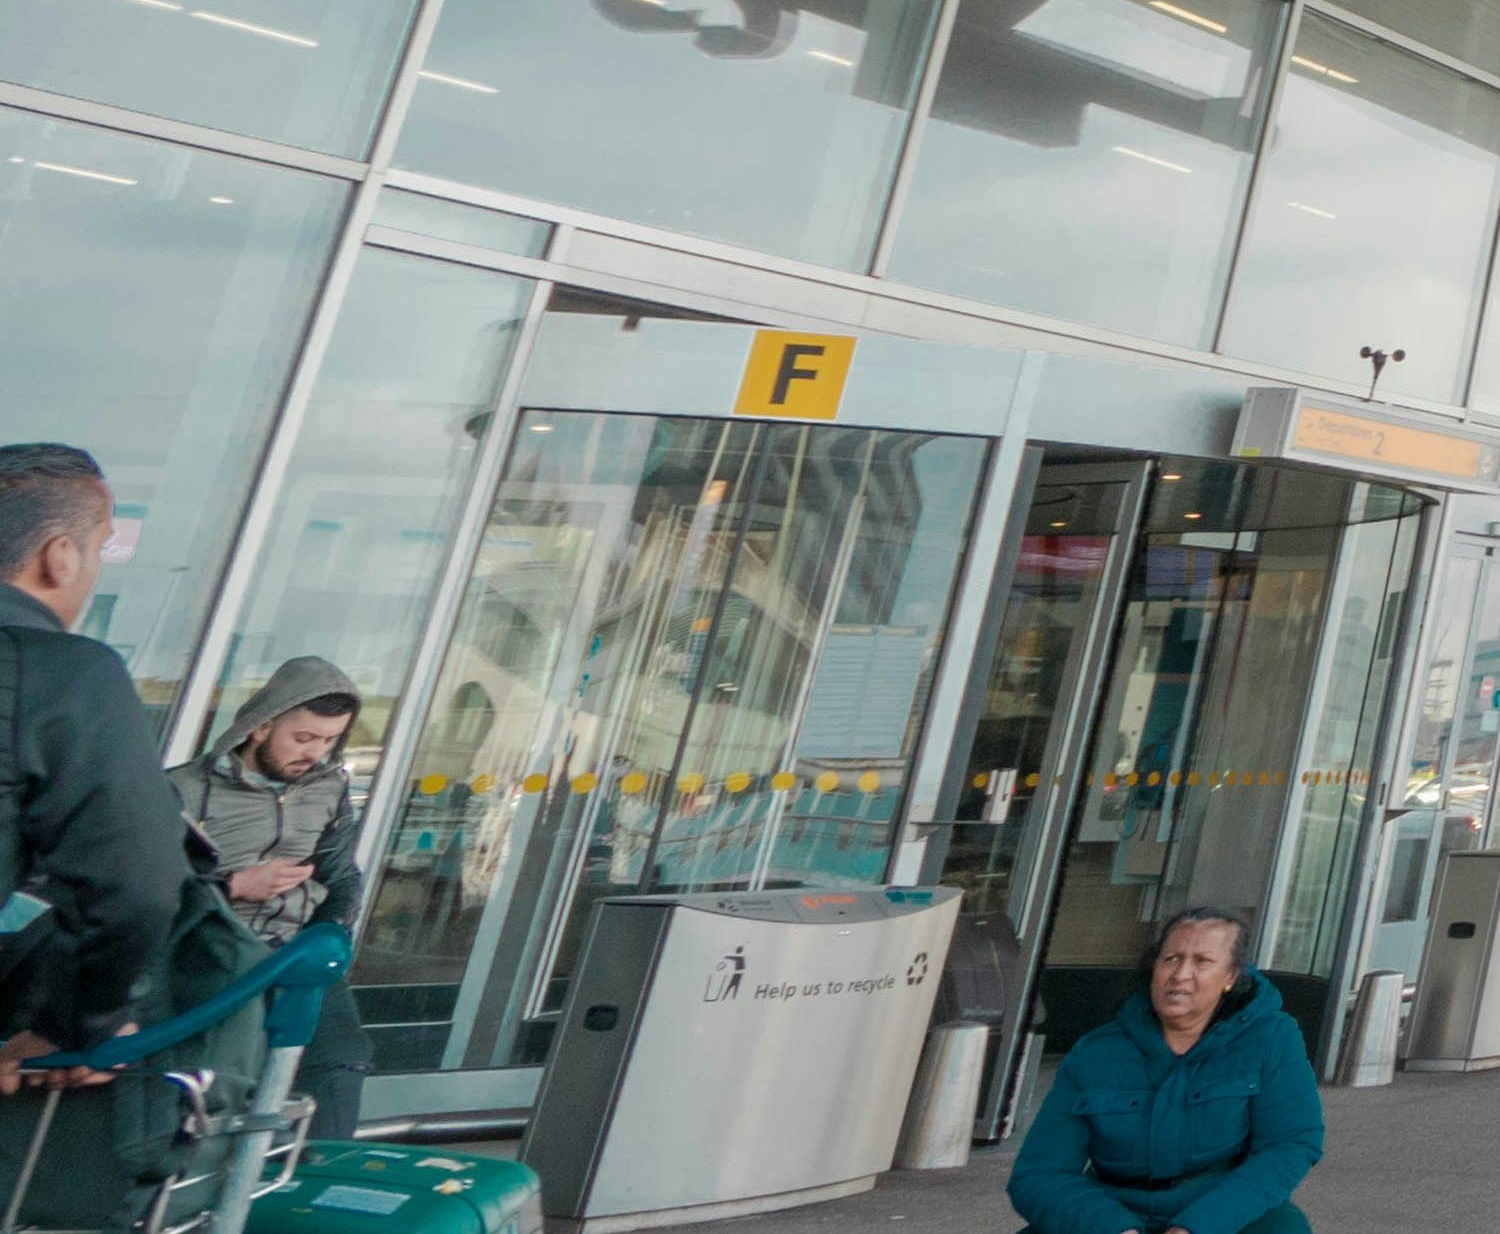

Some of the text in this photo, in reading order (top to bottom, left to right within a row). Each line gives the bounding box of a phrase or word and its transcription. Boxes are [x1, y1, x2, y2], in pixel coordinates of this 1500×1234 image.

[768, 343, 827, 405] F
[1372, 431, 1386, 456] 2
[754, 973, 895, 1002] Help us to recycle
